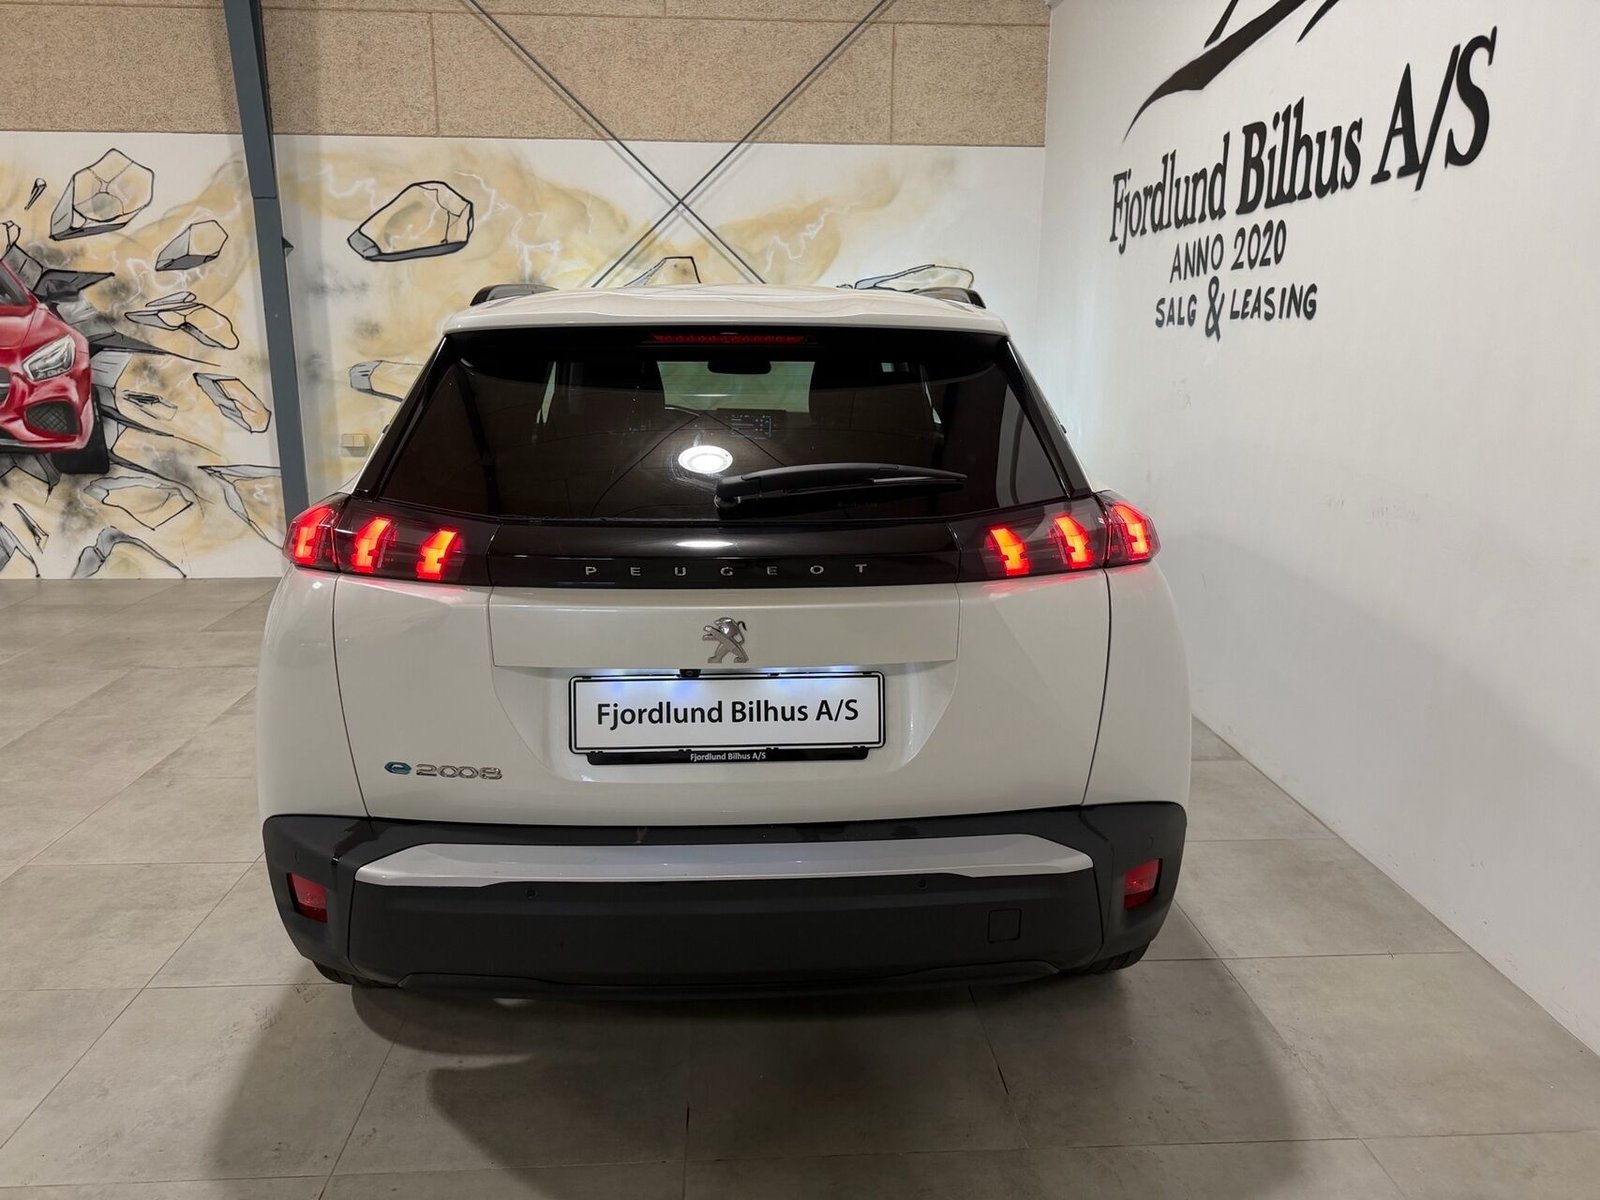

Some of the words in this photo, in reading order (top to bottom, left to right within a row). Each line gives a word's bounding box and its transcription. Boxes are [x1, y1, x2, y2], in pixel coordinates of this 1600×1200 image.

[1109, 131, 1231, 255] Fjordlund
[1236, 96, 1363, 215] Bilhus
[1370, 26, 1498, 191] A/S
[1169, 233, 1225, 283] ANNO
[1230, 219, 1287, 271] 2020
[1155, 294, 1198, 328] SALG
[1204, 276, 1225, 342] &
[1229, 283, 1318, 321] LEASING
[585, 563, 868, 577] PEUGEOT
[597, 700, 723, 731] Fjordlund
[731, 700, 809, 723] Bilhus
[815, 699, 859, 722] A/S
[416, 763, 503, 780] 2008
[690, 752, 726, 762] Fjordlund
[727, 752, 751, 760] Bilhus
[752, 751, 766, 760] A/S
